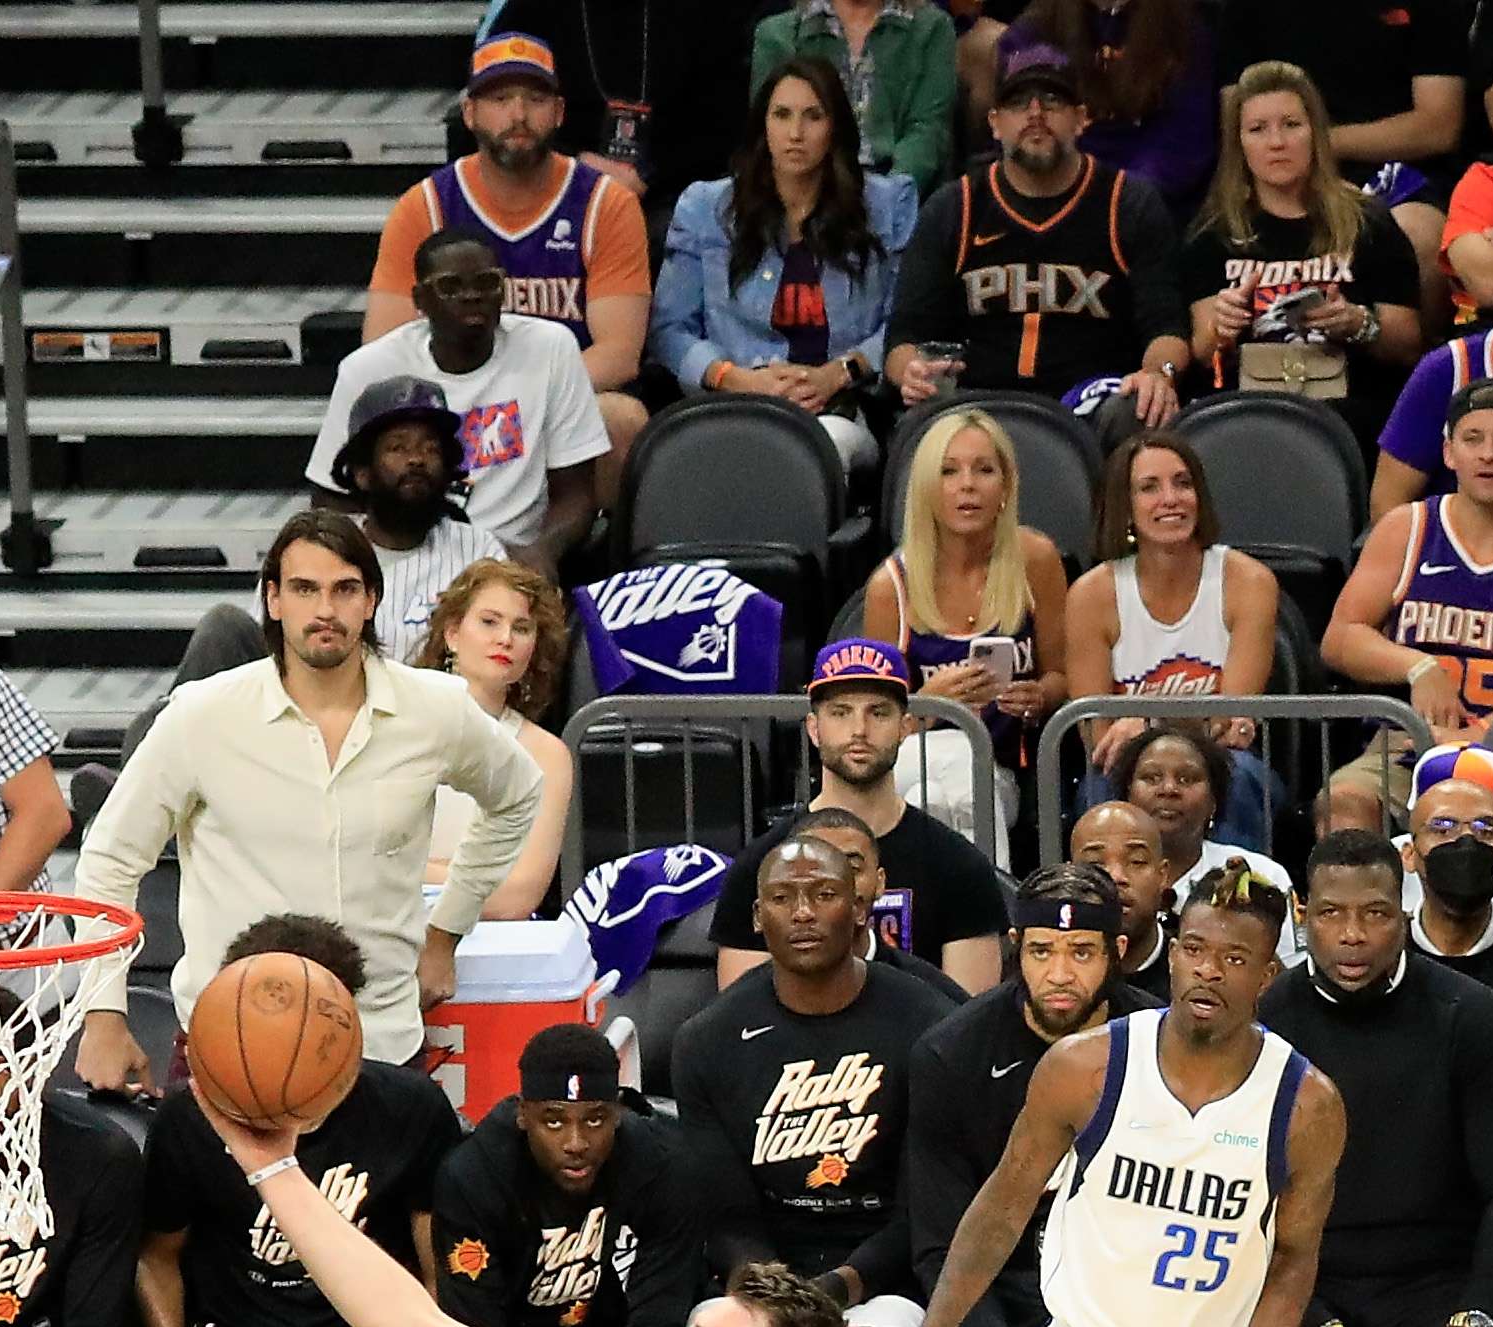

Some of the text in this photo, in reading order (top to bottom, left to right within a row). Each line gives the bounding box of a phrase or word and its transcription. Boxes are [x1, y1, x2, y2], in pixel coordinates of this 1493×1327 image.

[963, 262, 1109, 320] PHX
[1016, 312, 1042, 379] 1
[587, 562, 761, 633] Valley
[821, 644, 894, 681] PHOENIX
[762, 1052, 885, 1116] Rally
[751, 1106, 880, 1166] Valley
[782, 1114, 808, 1129] THE
[1212, 1129, 1259, 1149] chime
[1107, 1154, 1252, 1222] DALLAS
[1152, 1222, 1241, 1296] 25
